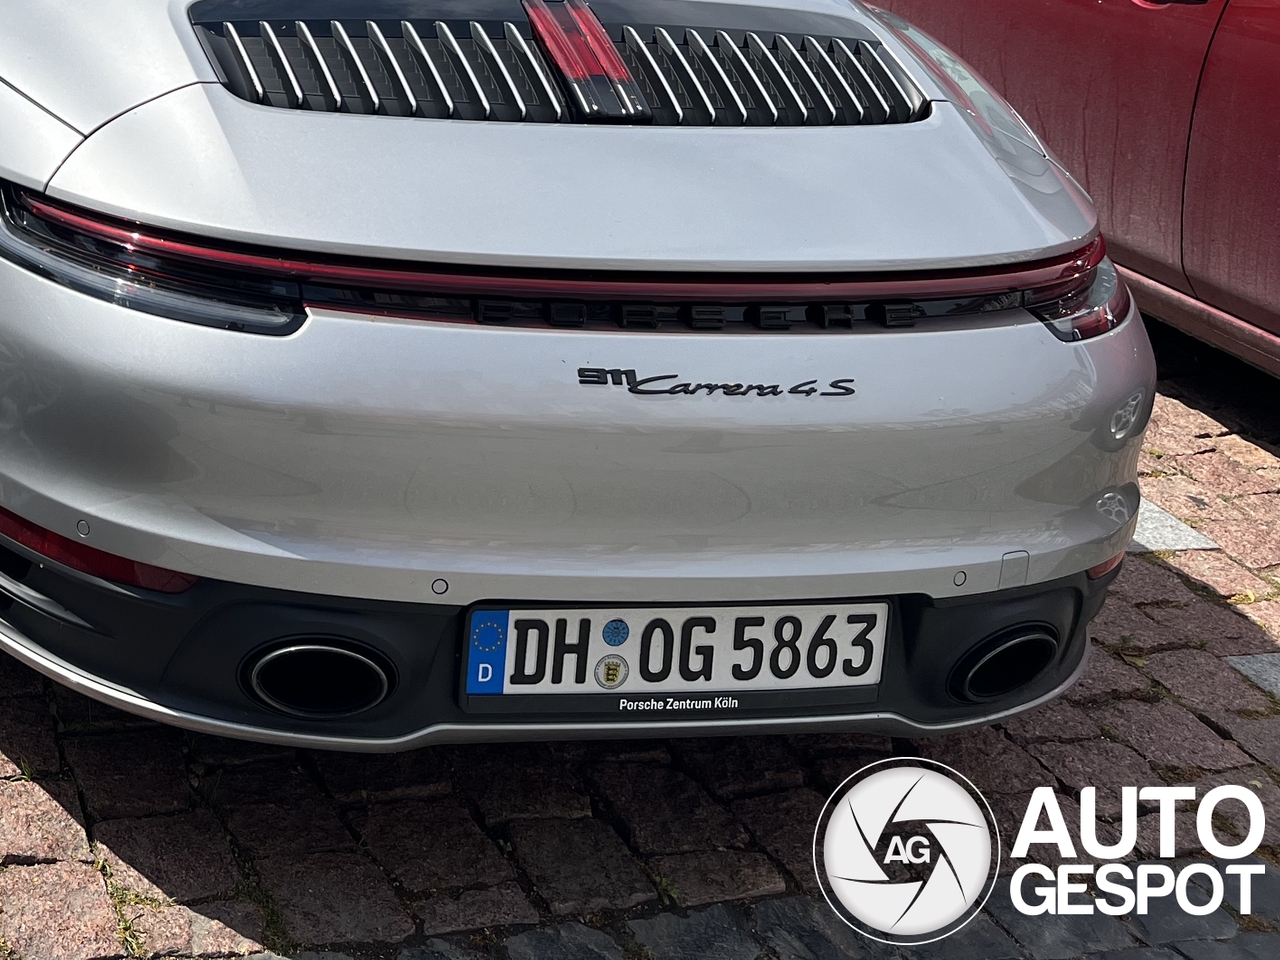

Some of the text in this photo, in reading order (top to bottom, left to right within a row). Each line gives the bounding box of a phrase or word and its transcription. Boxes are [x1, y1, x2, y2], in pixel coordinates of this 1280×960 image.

[577, 367, 637, 386] 911
[628, 374, 783, 397] Carrera
[509, 618, 591, 685] DH
[639, 616, 717, 682] OG
[731, 614, 878, 680] 5863
[477, 663, 492, 683] D
[619, 696, 738, 710] Porsche Zentrum Köln
